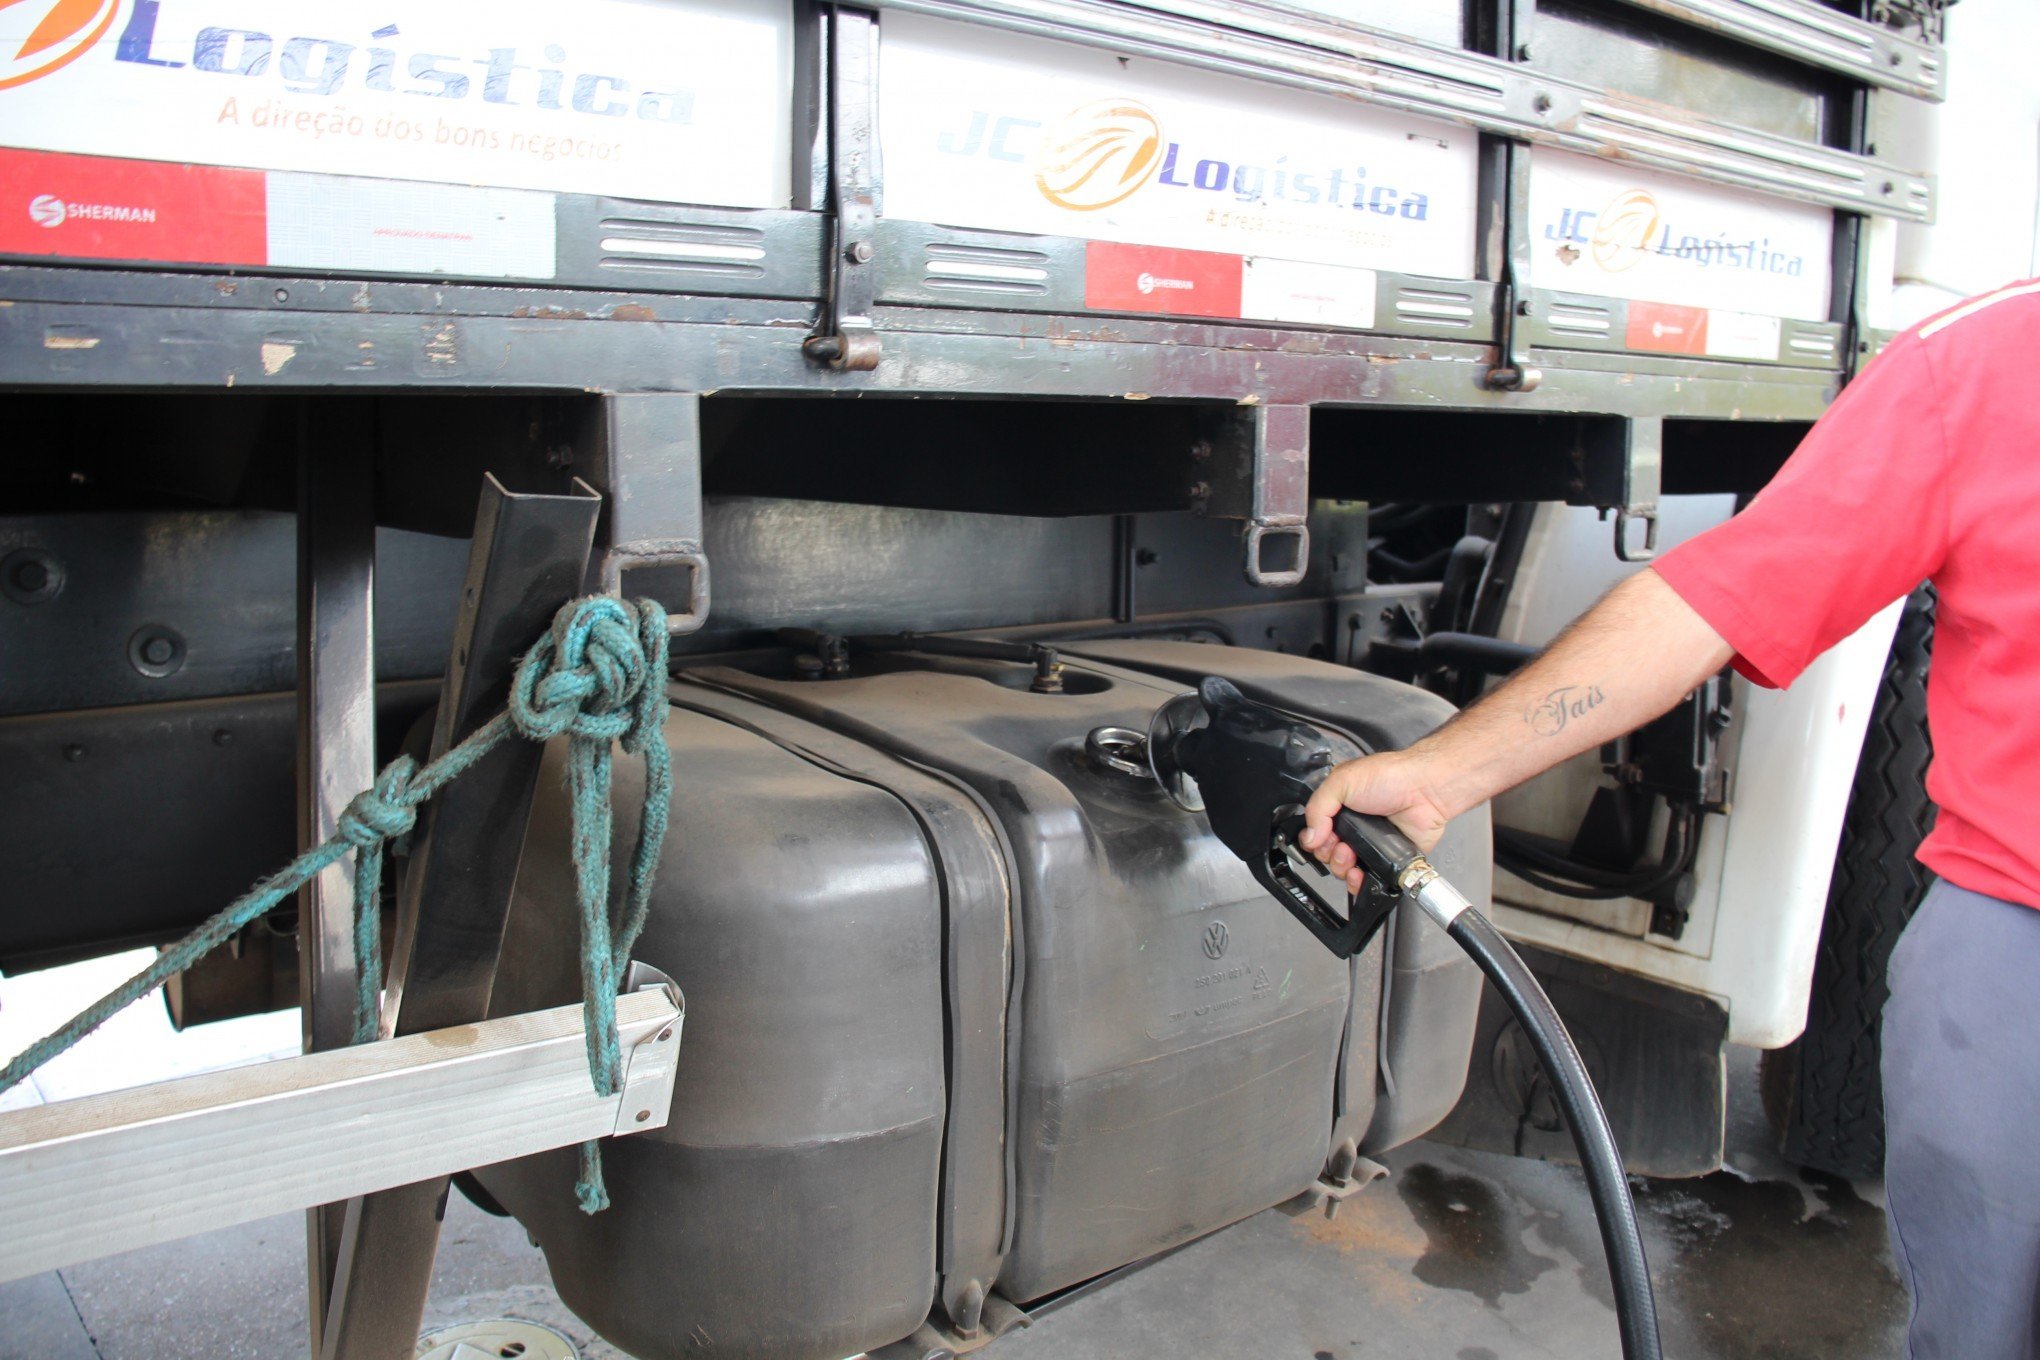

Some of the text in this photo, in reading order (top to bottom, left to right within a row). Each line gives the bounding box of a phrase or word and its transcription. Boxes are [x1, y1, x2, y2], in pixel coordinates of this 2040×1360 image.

[114, 0, 695, 125] Logística
[217, 96, 239, 125] A
[252, 100, 363, 139] direção
[375, 112, 423, 141] dos
[435, 117, 499, 149] bons
[936, 109, 1429, 222] JC Logística
[67, 203, 156, 223] SHERMAN
[1544, 207, 1803, 277] JC Logística
